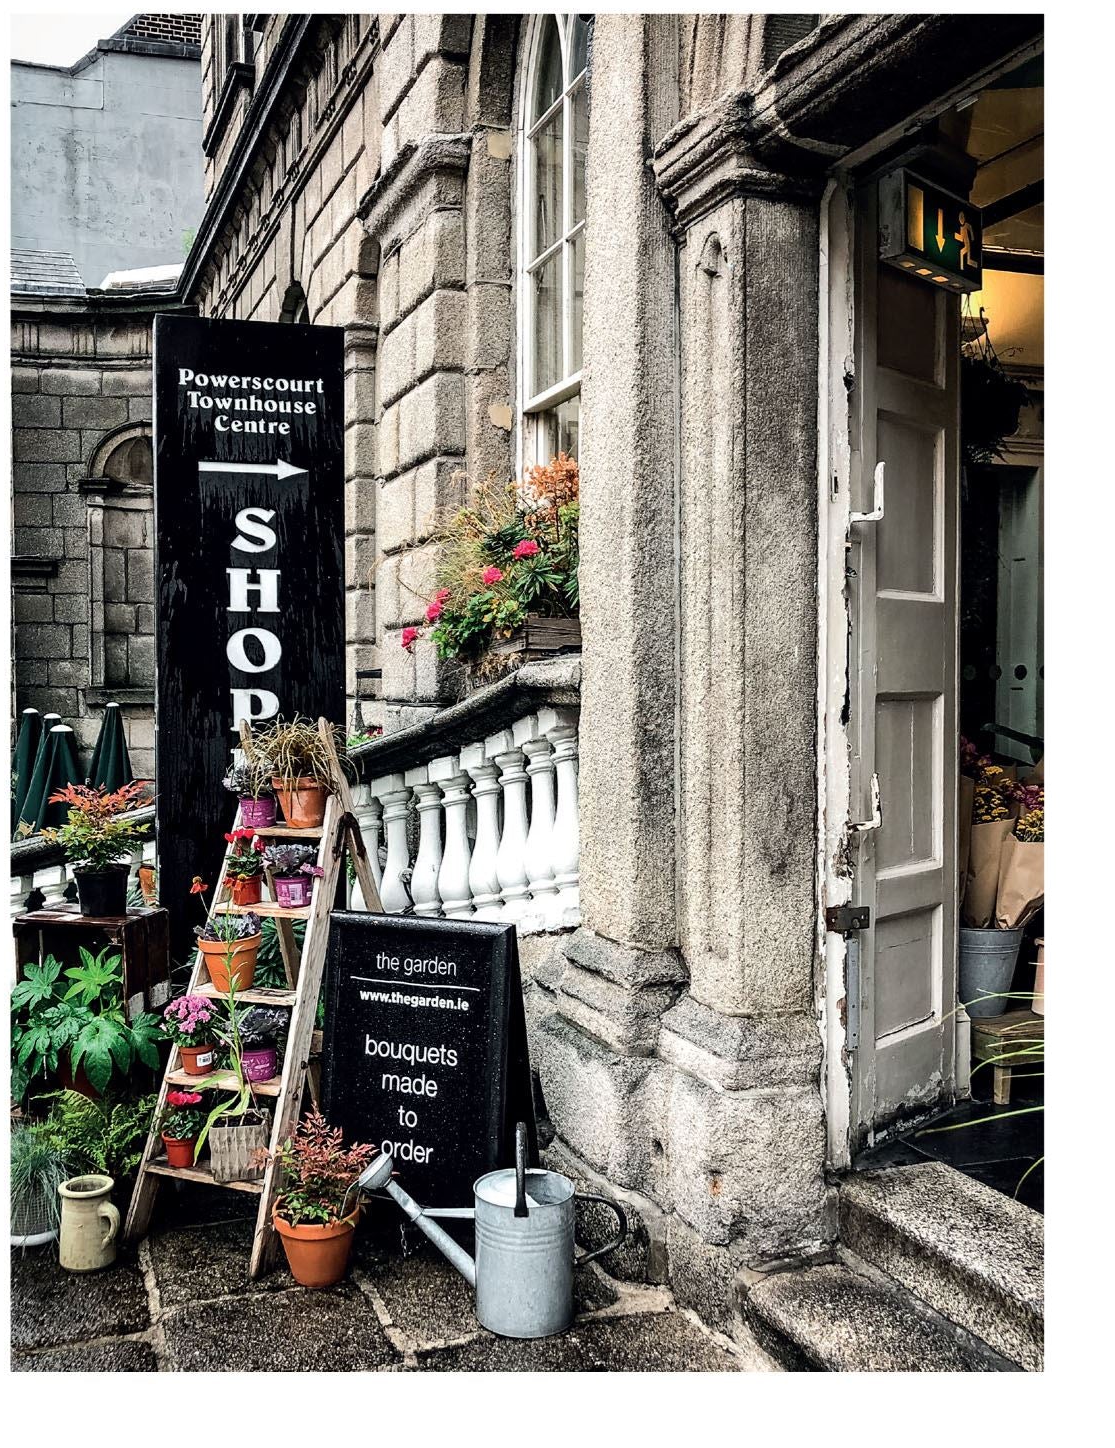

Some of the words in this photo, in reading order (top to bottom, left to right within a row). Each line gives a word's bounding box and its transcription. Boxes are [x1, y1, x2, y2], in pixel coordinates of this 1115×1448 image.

[178, 367, 324, 394] Powerscourt
[187, 390, 317, 415] Townhouse
[214, 414, 291, 435] Centre
[376, 952, 400, 971] the
[404, 956, 457, 977] garden
[359, 990, 470, 1011] www.thegarden.ie
[365, 1033, 458, 1067] bouquets
[381, 1073, 438, 1098] made
[398, 1105, 418, 1128] to
[381, 1139, 434, 1164] order
